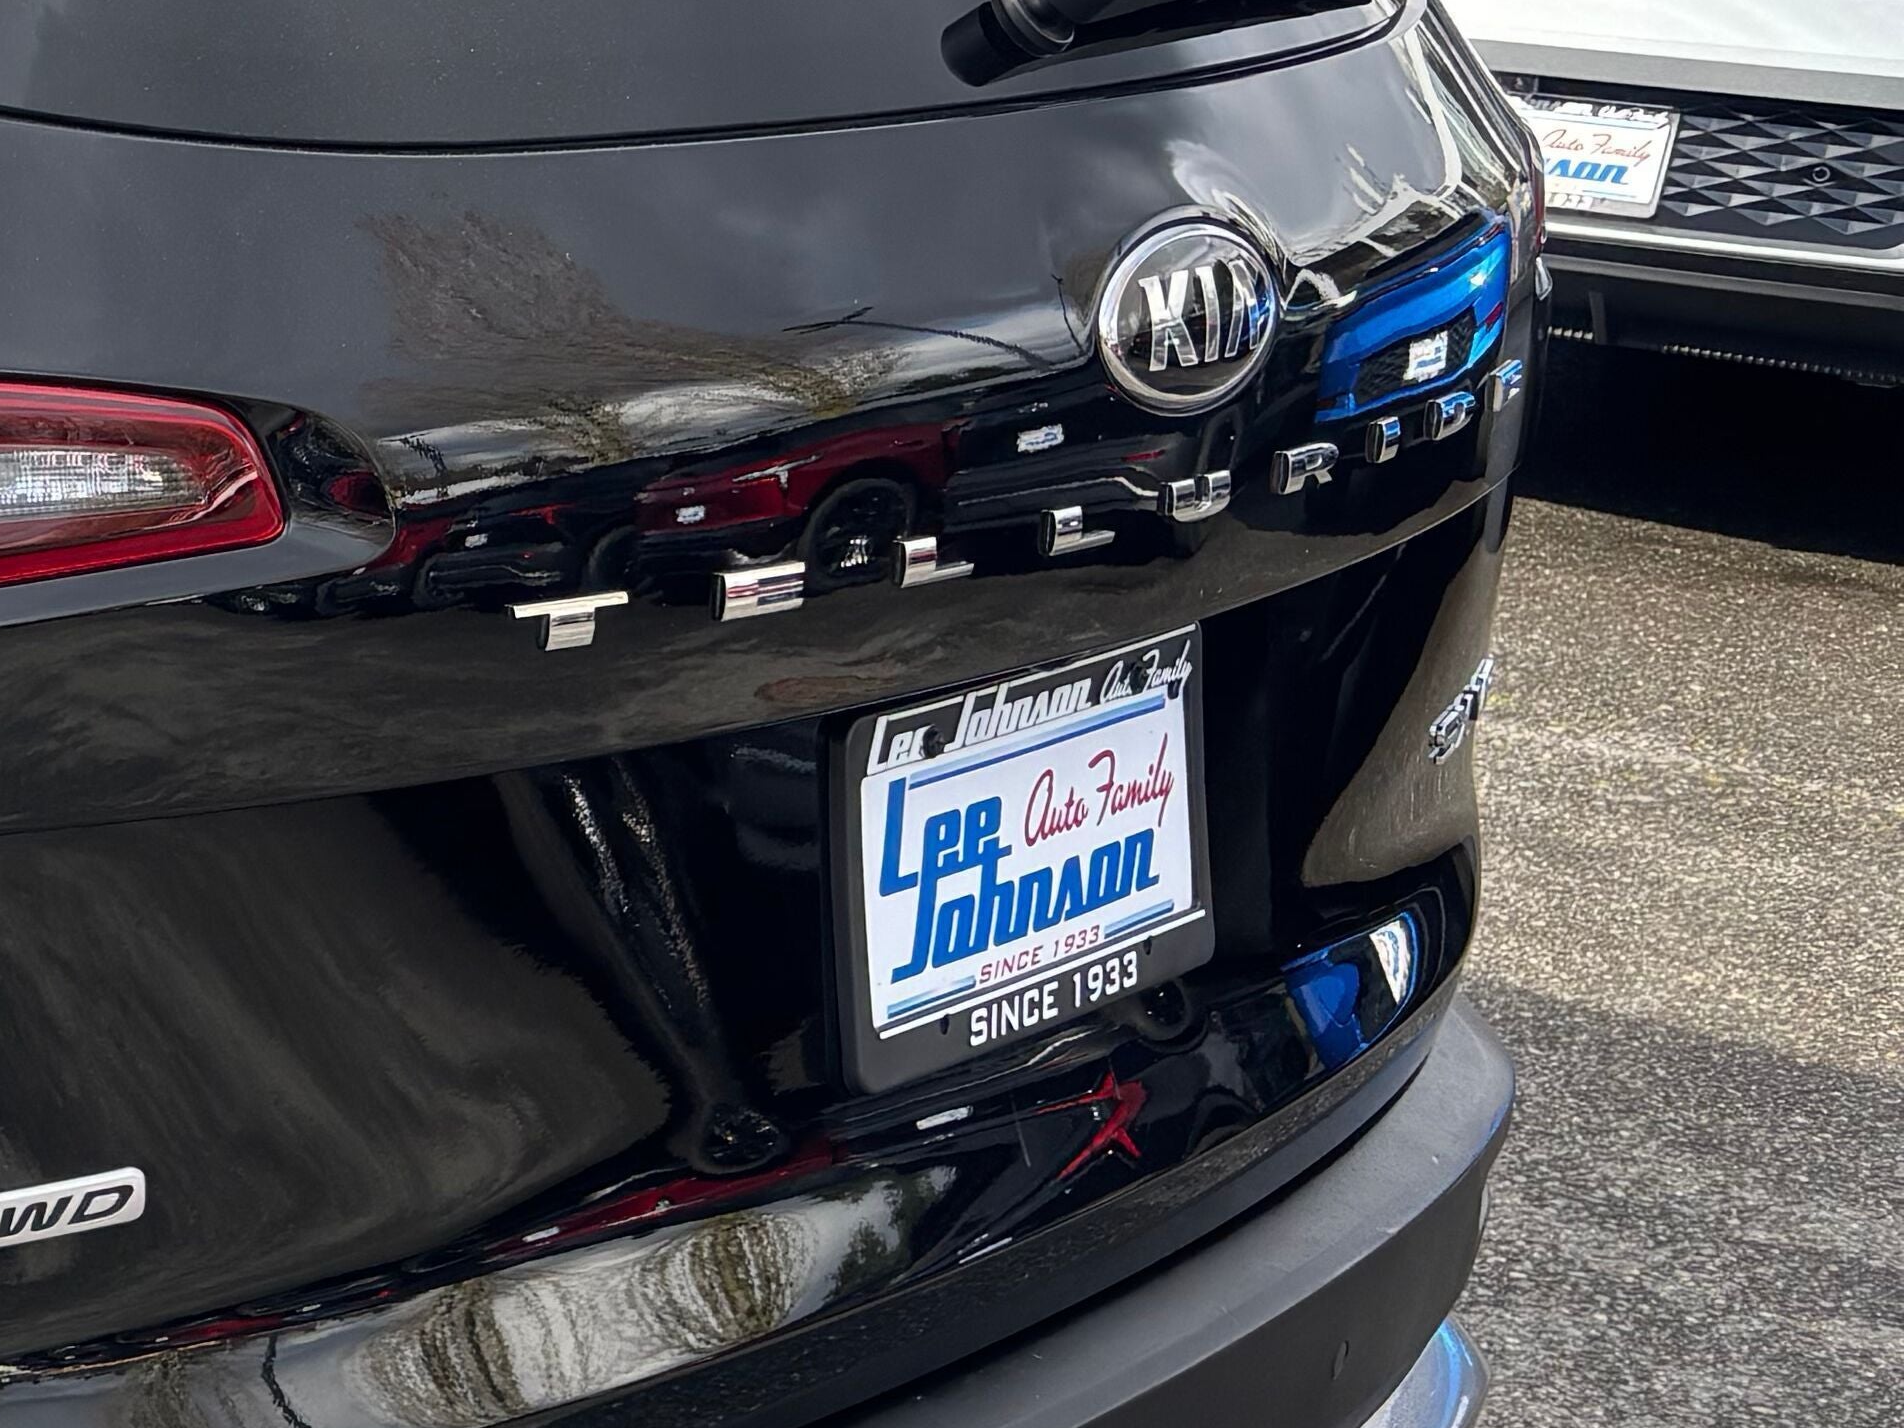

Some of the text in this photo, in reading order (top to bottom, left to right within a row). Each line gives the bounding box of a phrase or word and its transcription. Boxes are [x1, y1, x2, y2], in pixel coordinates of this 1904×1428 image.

[1591, 133, 1652, 167] Family
[1138, 259, 1260, 372] KIA
[506, 359, 1523, 652] TELLURIDE
[944, 678, 1092, 753] Johnson
[1100, 660, 1134, 704] Aut
[1142, 639, 1193, 694] Family
[879, 776, 1004, 897] Lee
[1024, 733, 1174, 847] Auto Family
[890, 828, 1160, 985] Johnson
[979, 924, 1101, 984] SINCE 1933
[970, 950, 1138, 1047] SINCE 1933
